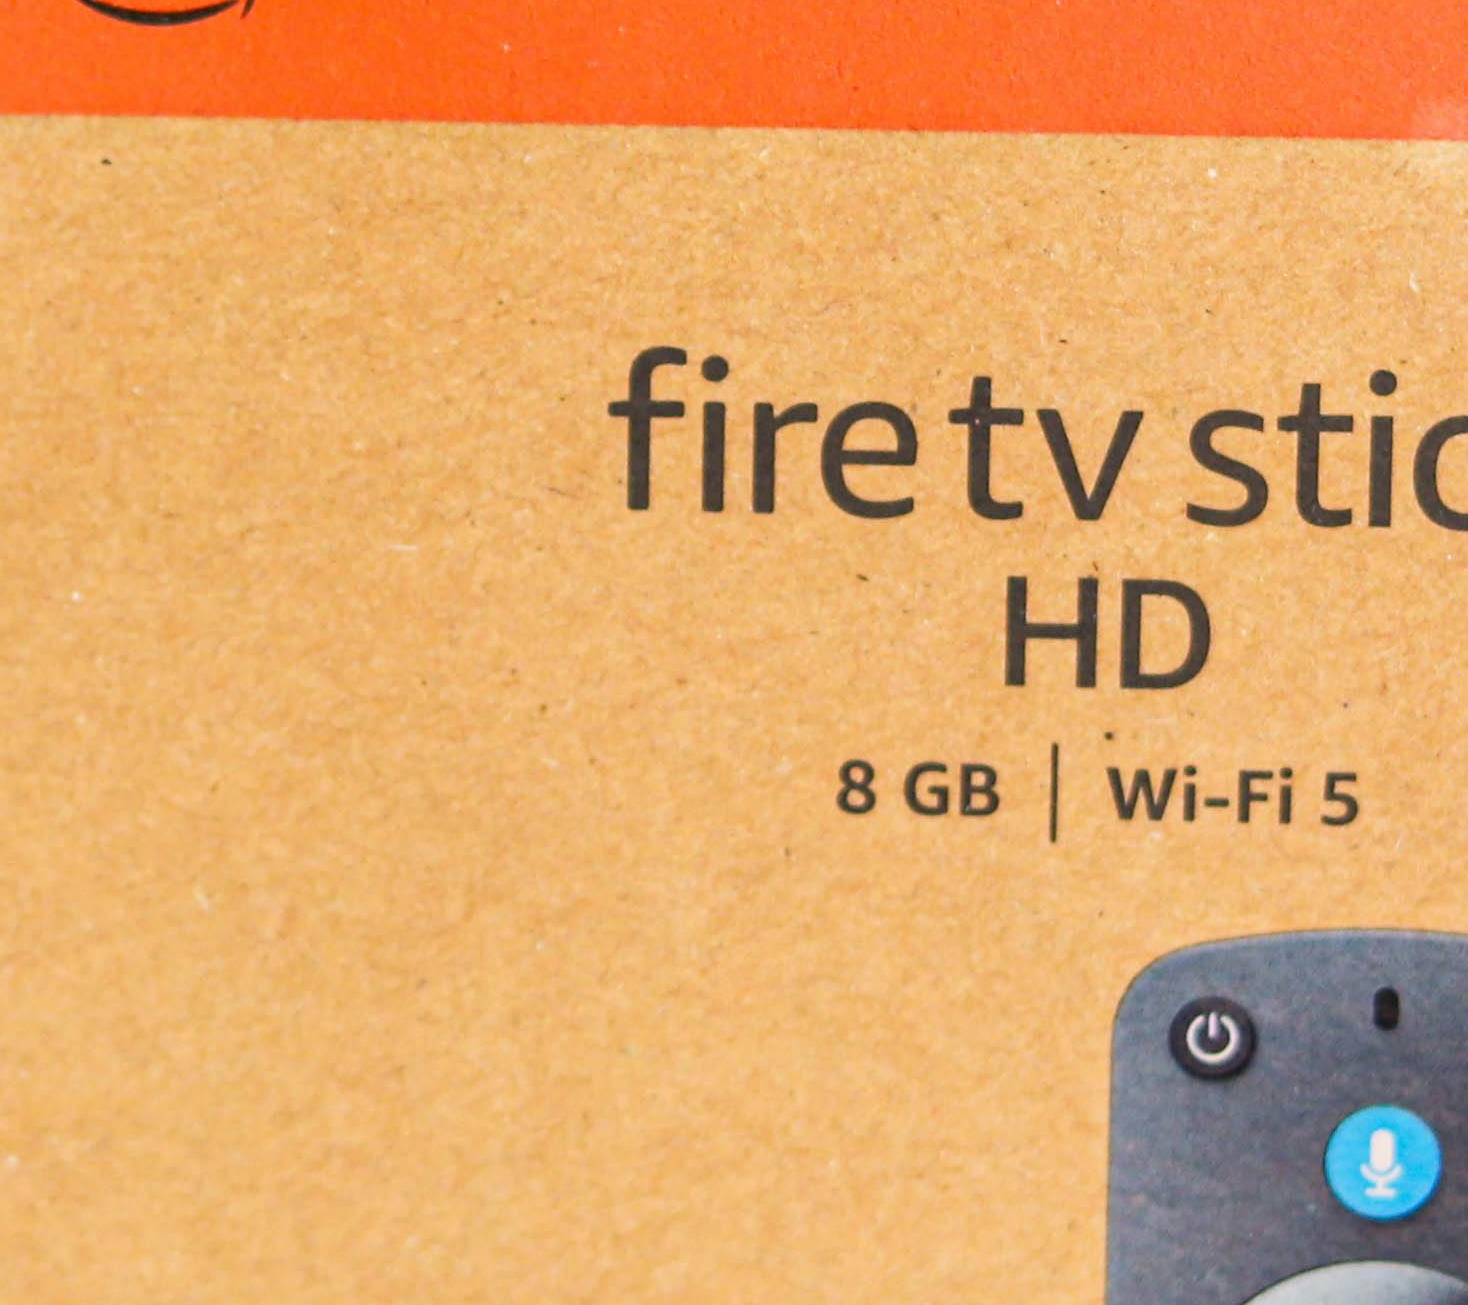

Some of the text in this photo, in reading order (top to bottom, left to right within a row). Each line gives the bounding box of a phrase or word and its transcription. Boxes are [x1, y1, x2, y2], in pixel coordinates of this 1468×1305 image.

[607, 345, 919, 520] fire
[947, 375, 1144, 522] tv
[1004, 575, 1212, 691] HD
[835, 758, 1361, 827] 8 GB Wi-Fi 5
